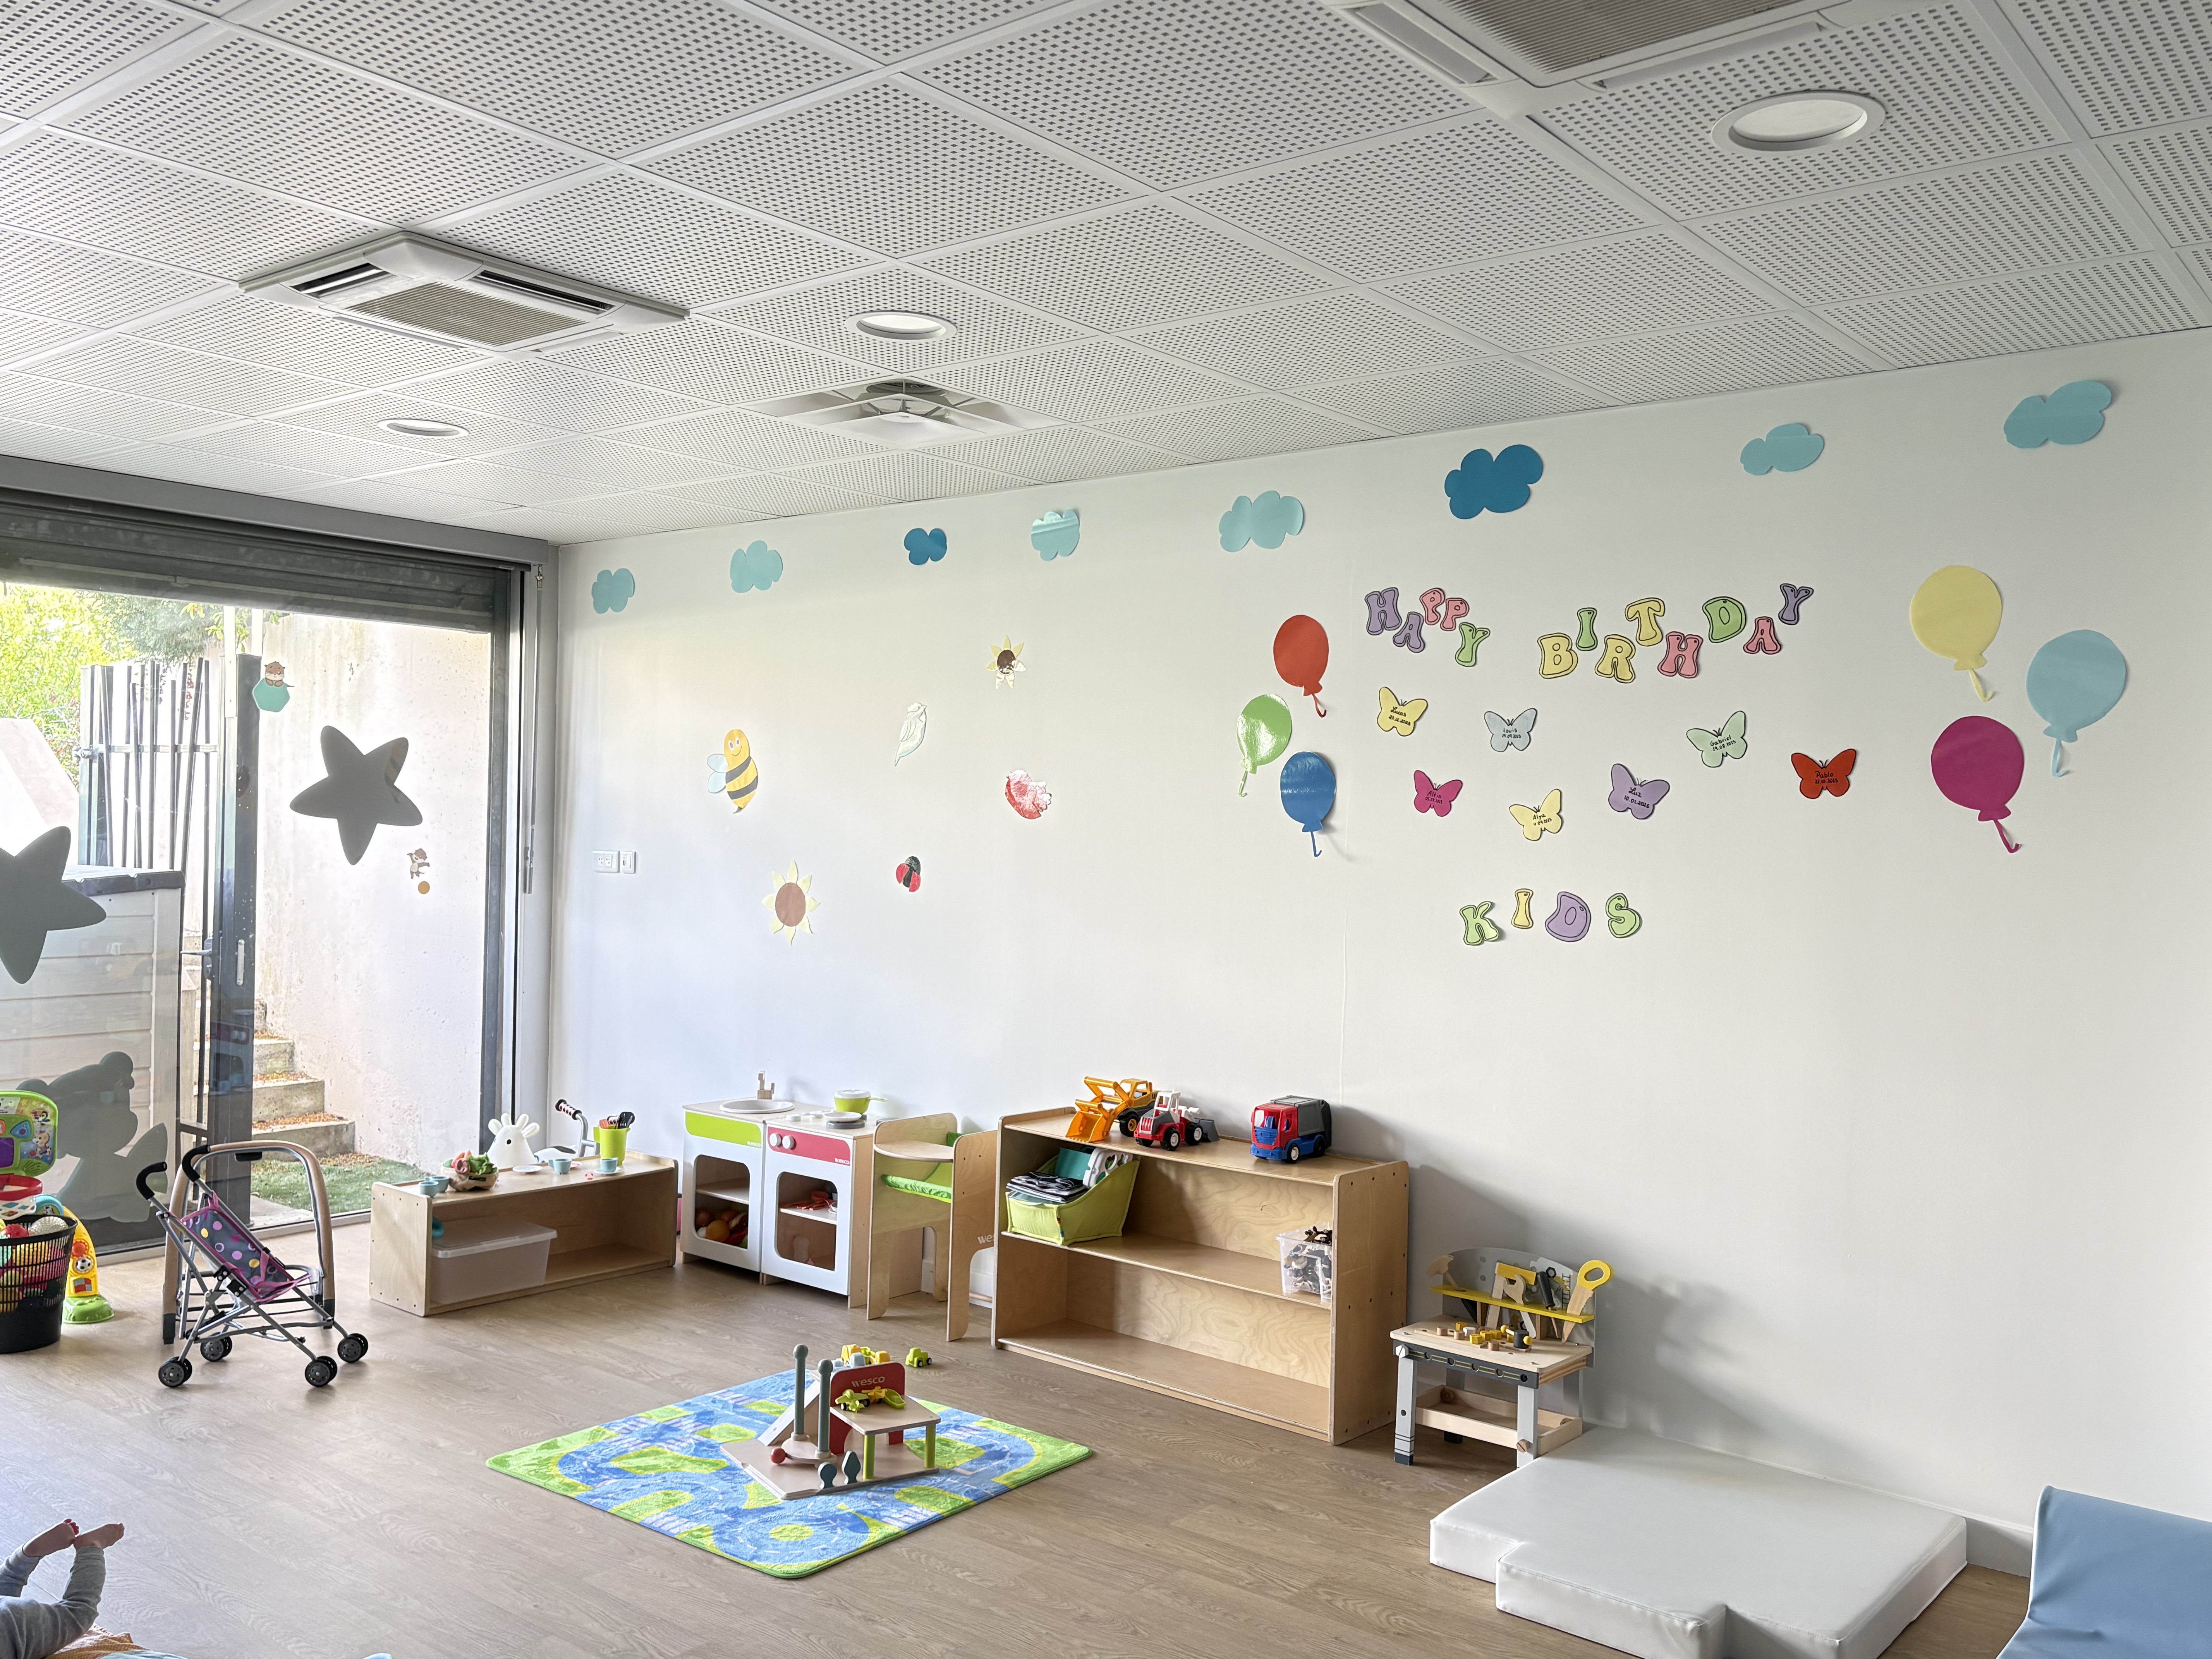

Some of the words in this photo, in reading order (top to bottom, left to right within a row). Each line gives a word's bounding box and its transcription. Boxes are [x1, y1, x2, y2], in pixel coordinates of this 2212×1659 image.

[1364, 587, 1491, 667] HAPPY
[1537, 583, 1814, 683] BIRTHDAY
[1390, 706, 1407, 717] Lucas
[1710, 735, 1731, 746] Gabriel
[1628, 787, 1642, 798] Luz
[1460, 888, 1641, 945] KIDS
